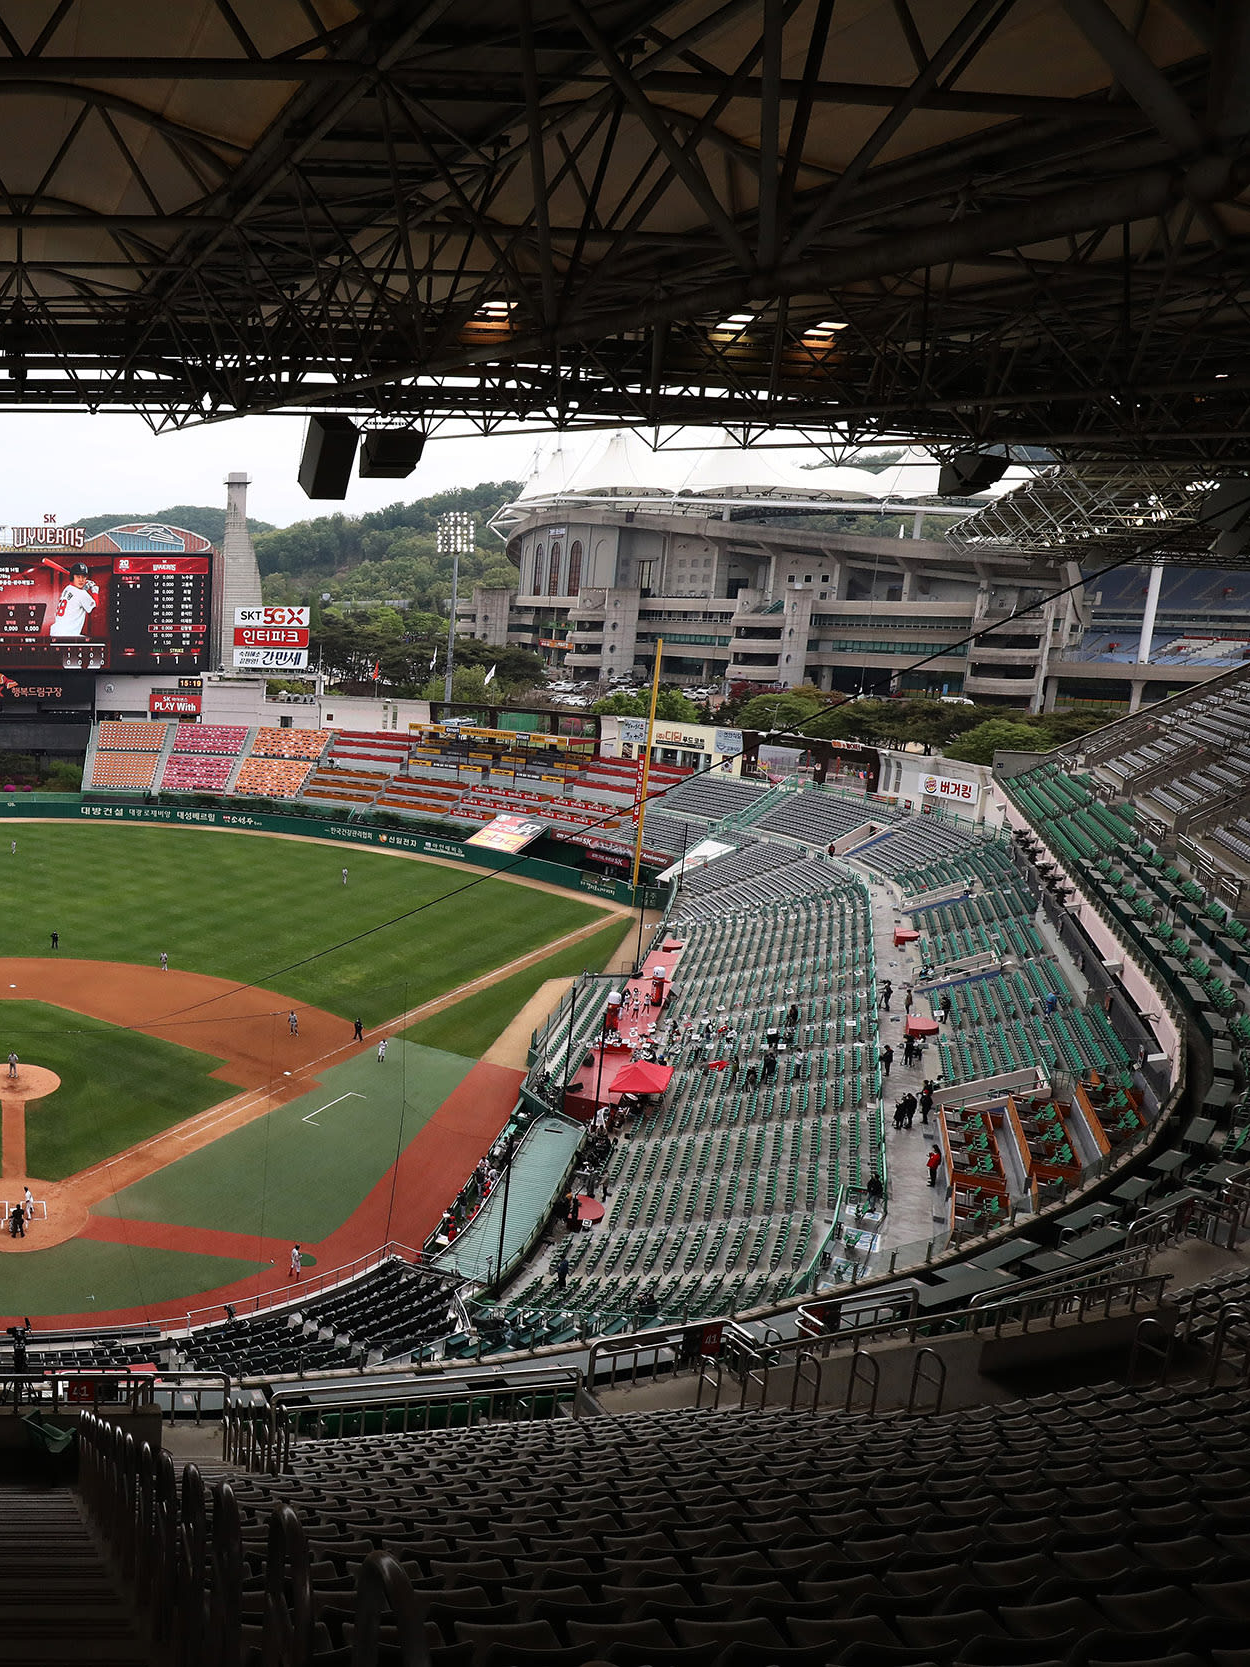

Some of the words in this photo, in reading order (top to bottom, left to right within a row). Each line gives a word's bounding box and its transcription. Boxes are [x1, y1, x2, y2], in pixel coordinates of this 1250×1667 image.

[44, 514, 56, 523] SK
[11, 527, 86, 549] WYVERNS
[241, 611, 262, 620] SKT
[263, 607, 304, 625] 5GX
[242, 630, 299, 645] 인터파크
[156, 656, 160, 664] 1
[175, 656, 179, 664] 1
[194, 656, 198, 664] 1
[262, 651, 302, 666] 간만세
[11, 687, 63, 698] 행복드림구장
[154, 701, 175, 711] PLAY
[176, 702, 196, 712] With
[940, 780, 972, 799] 버거킹
[81, 806, 124, 817] 대방건설
[177, 811, 216, 822] 대성베르힐
[330, 826, 373, 840] 한국건강관리협회
[389, 836, 417, 847] 신일전자
[705, 1334, 718, 1345] 41
[71, 1385, 90, 1397] 41
